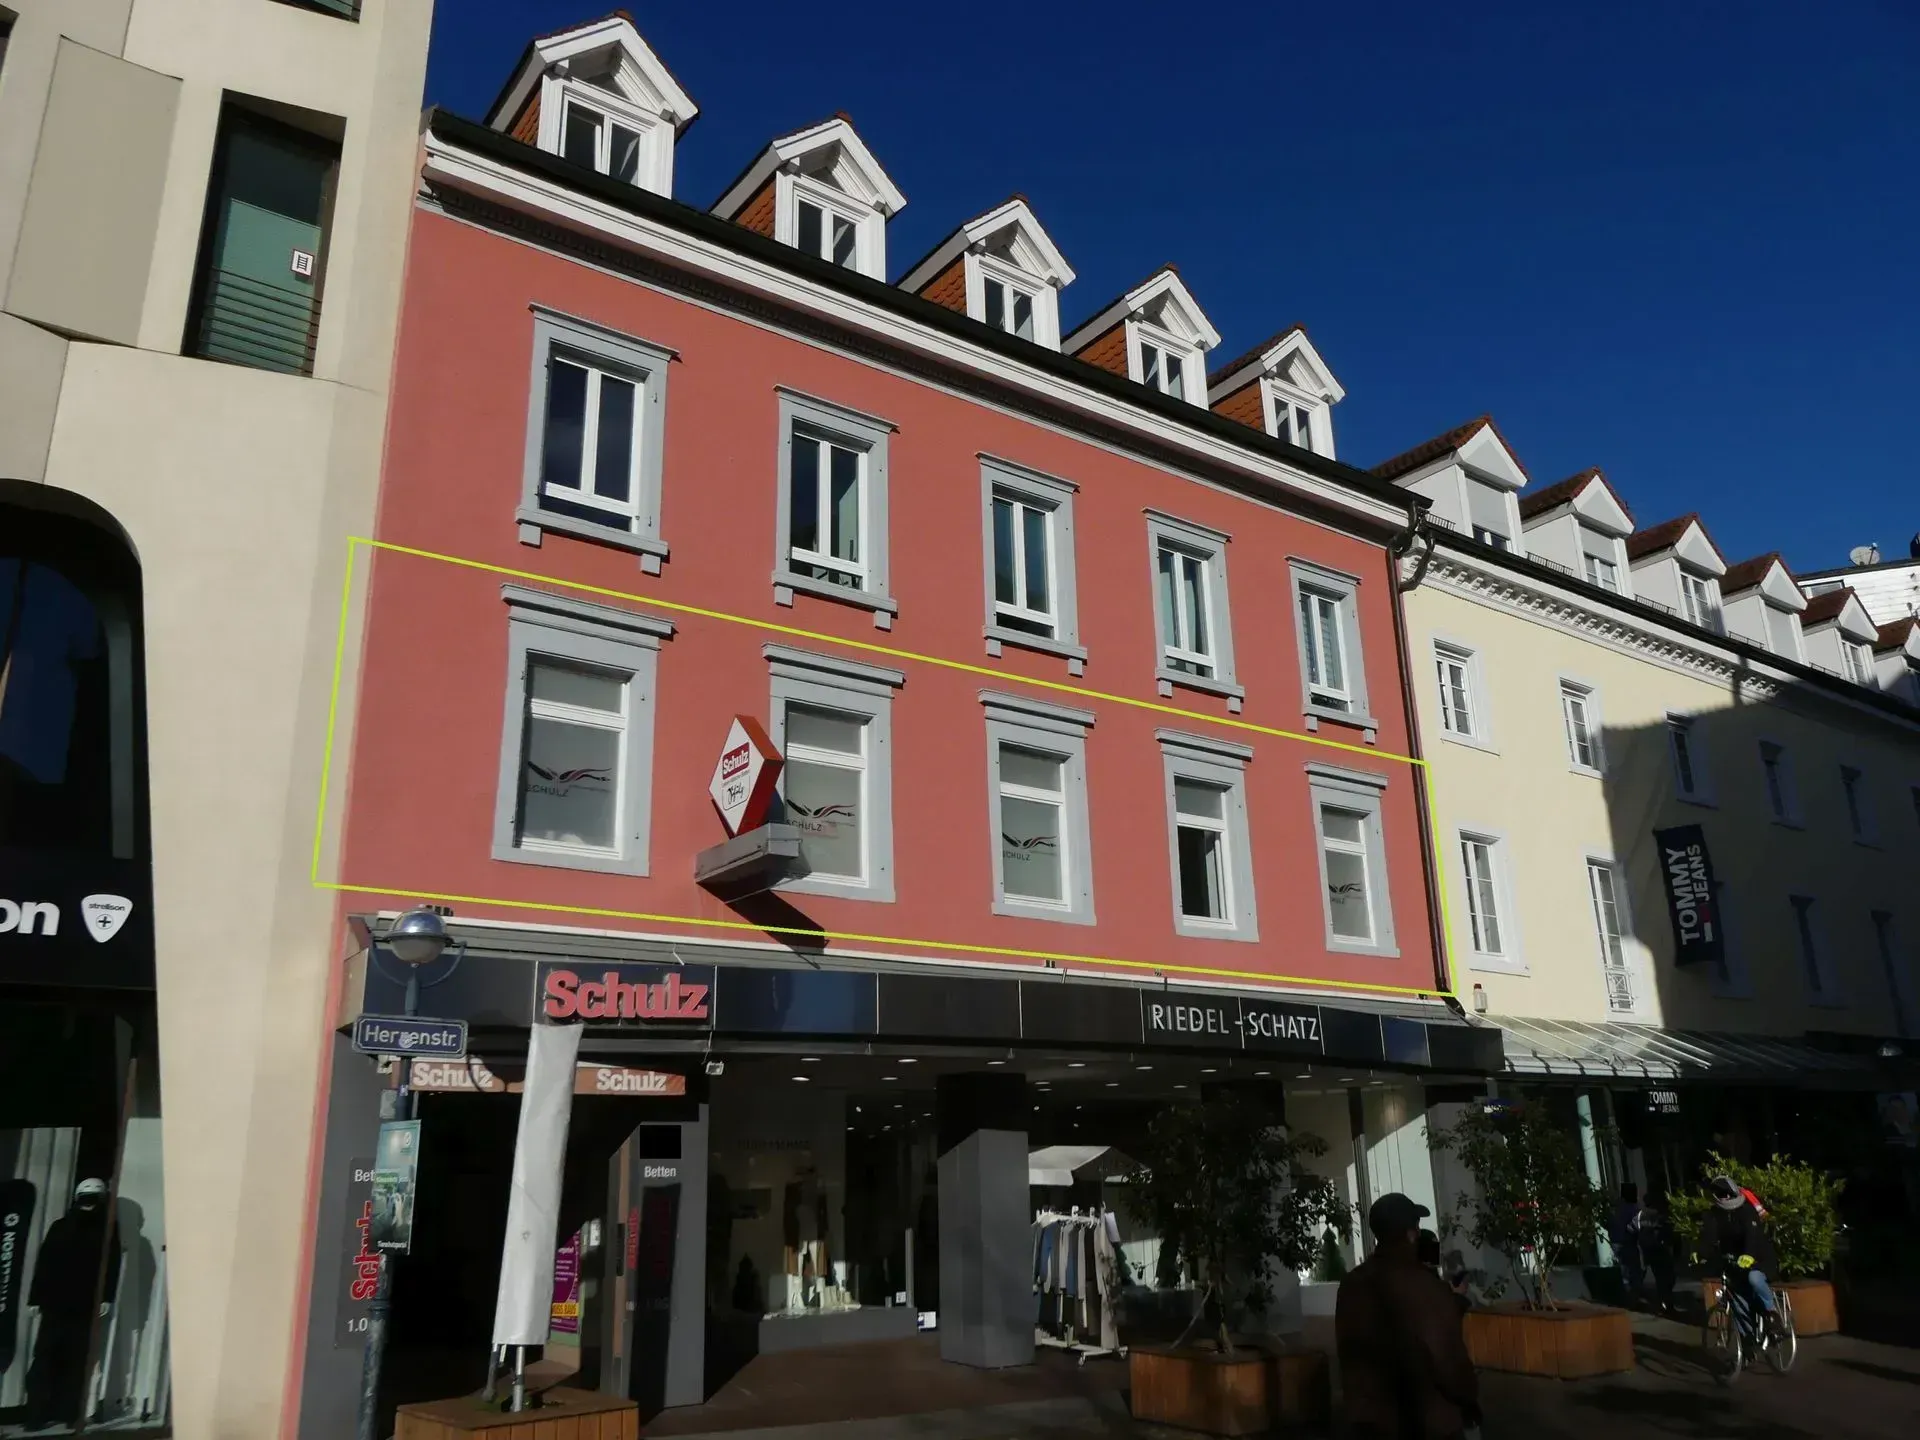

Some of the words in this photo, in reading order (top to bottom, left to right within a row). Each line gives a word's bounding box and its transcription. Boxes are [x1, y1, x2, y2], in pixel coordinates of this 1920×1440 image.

[722, 750, 749, 775] Schulz
[1687, 844, 1711, 902] JEANS
[88, 902, 126, 912] strellson
[1665, 847, 1701, 946] TOMMY
[545, 969, 709, 1020] Schulz
[596, 1068, 668, 1092] Schulz
[1648, 1091, 1678, 1104] TOMMY
[353, 1168, 376, 1183] Bet
[643, 1165, 677, 1179] Betten
